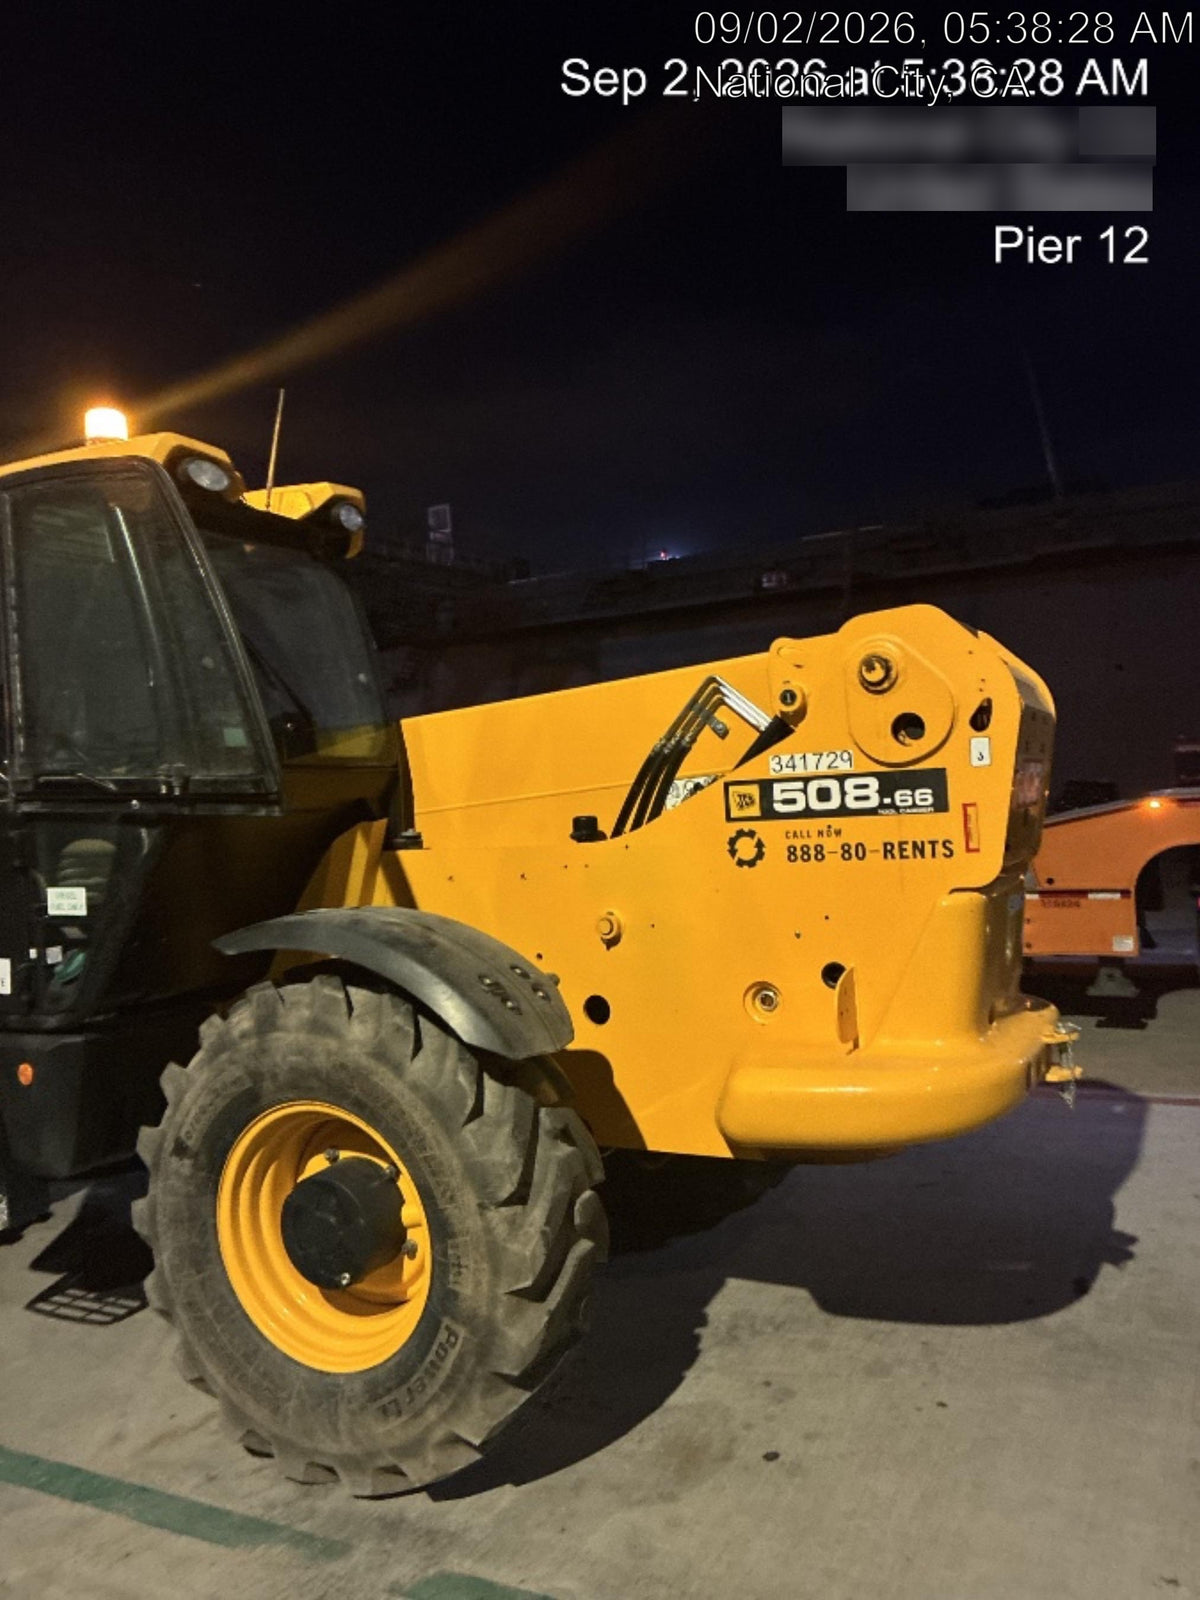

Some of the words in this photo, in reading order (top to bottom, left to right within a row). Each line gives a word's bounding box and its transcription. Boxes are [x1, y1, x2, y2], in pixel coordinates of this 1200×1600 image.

[771, 750, 853, 773] 341729
[785, 829, 812, 840] CALL
[817, 828, 843, 838] NOW
[786, 839, 954, 864] 888-80-RENTS
